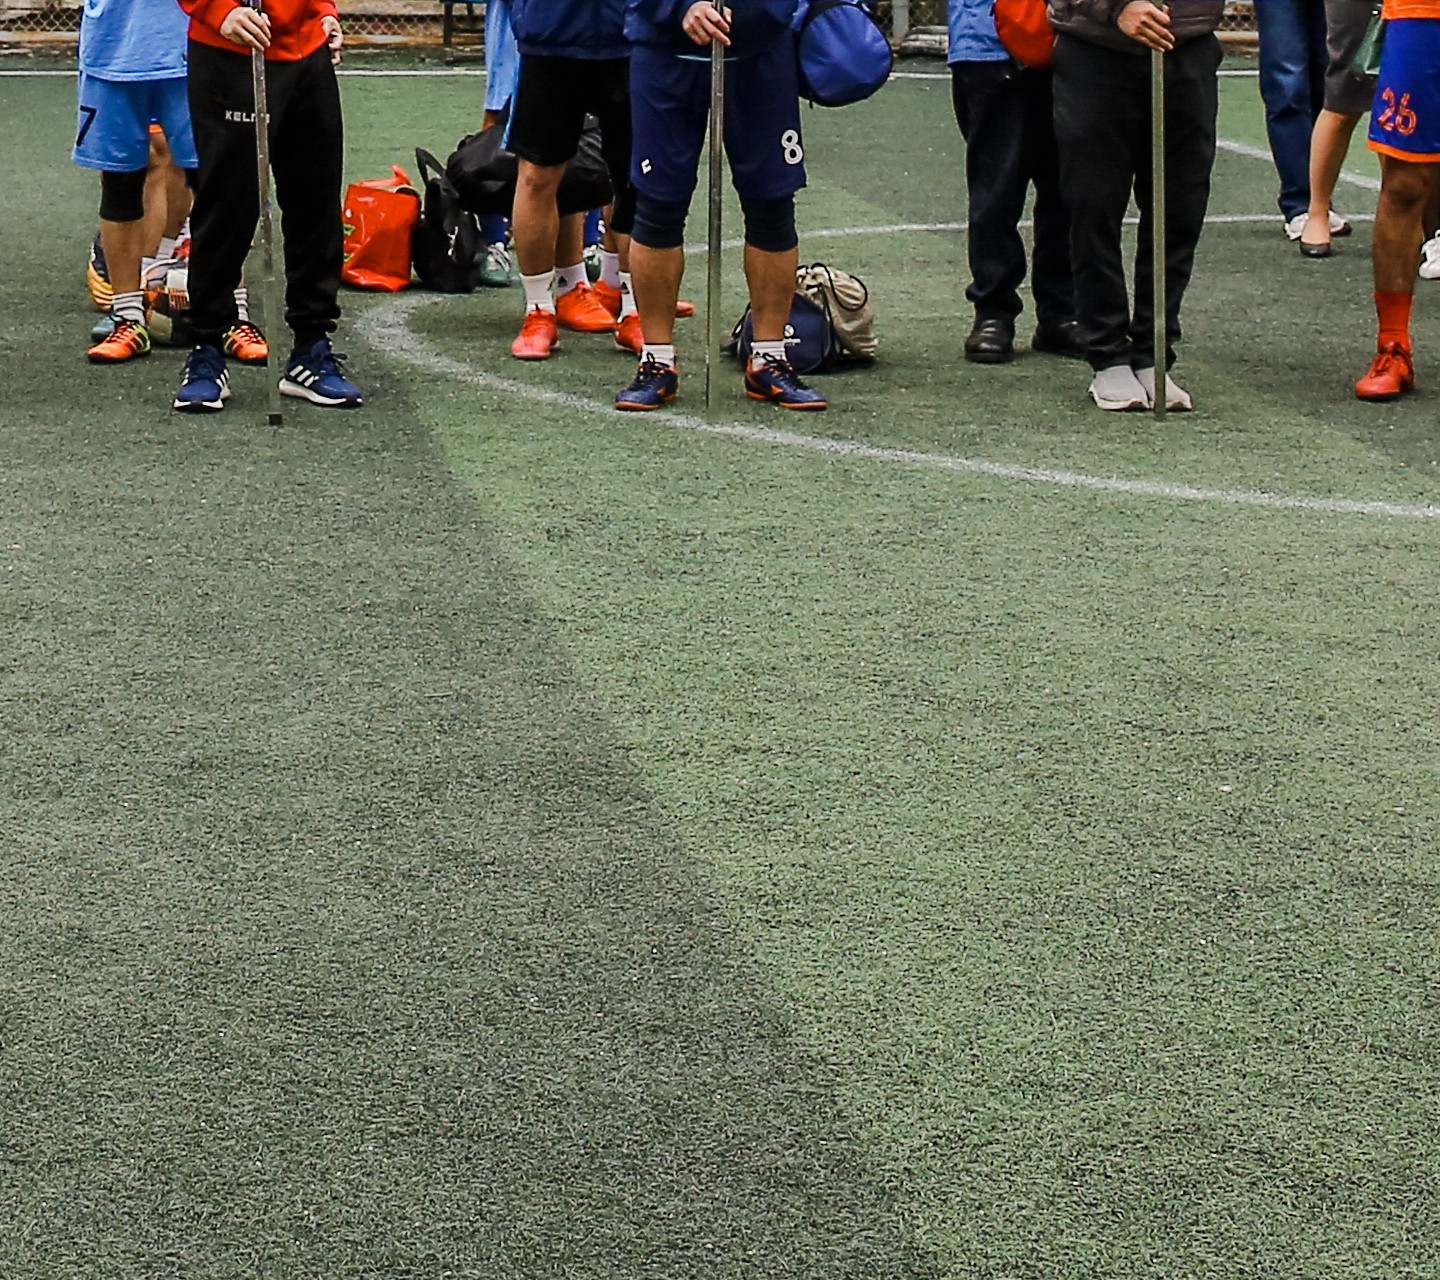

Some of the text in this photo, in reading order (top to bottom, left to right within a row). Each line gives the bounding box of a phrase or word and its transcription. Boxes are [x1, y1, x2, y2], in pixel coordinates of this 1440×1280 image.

[76, 105, 97, 146] 7
[1378, 87, 1417, 136] 26
[781, 129, 803, 165] 8
